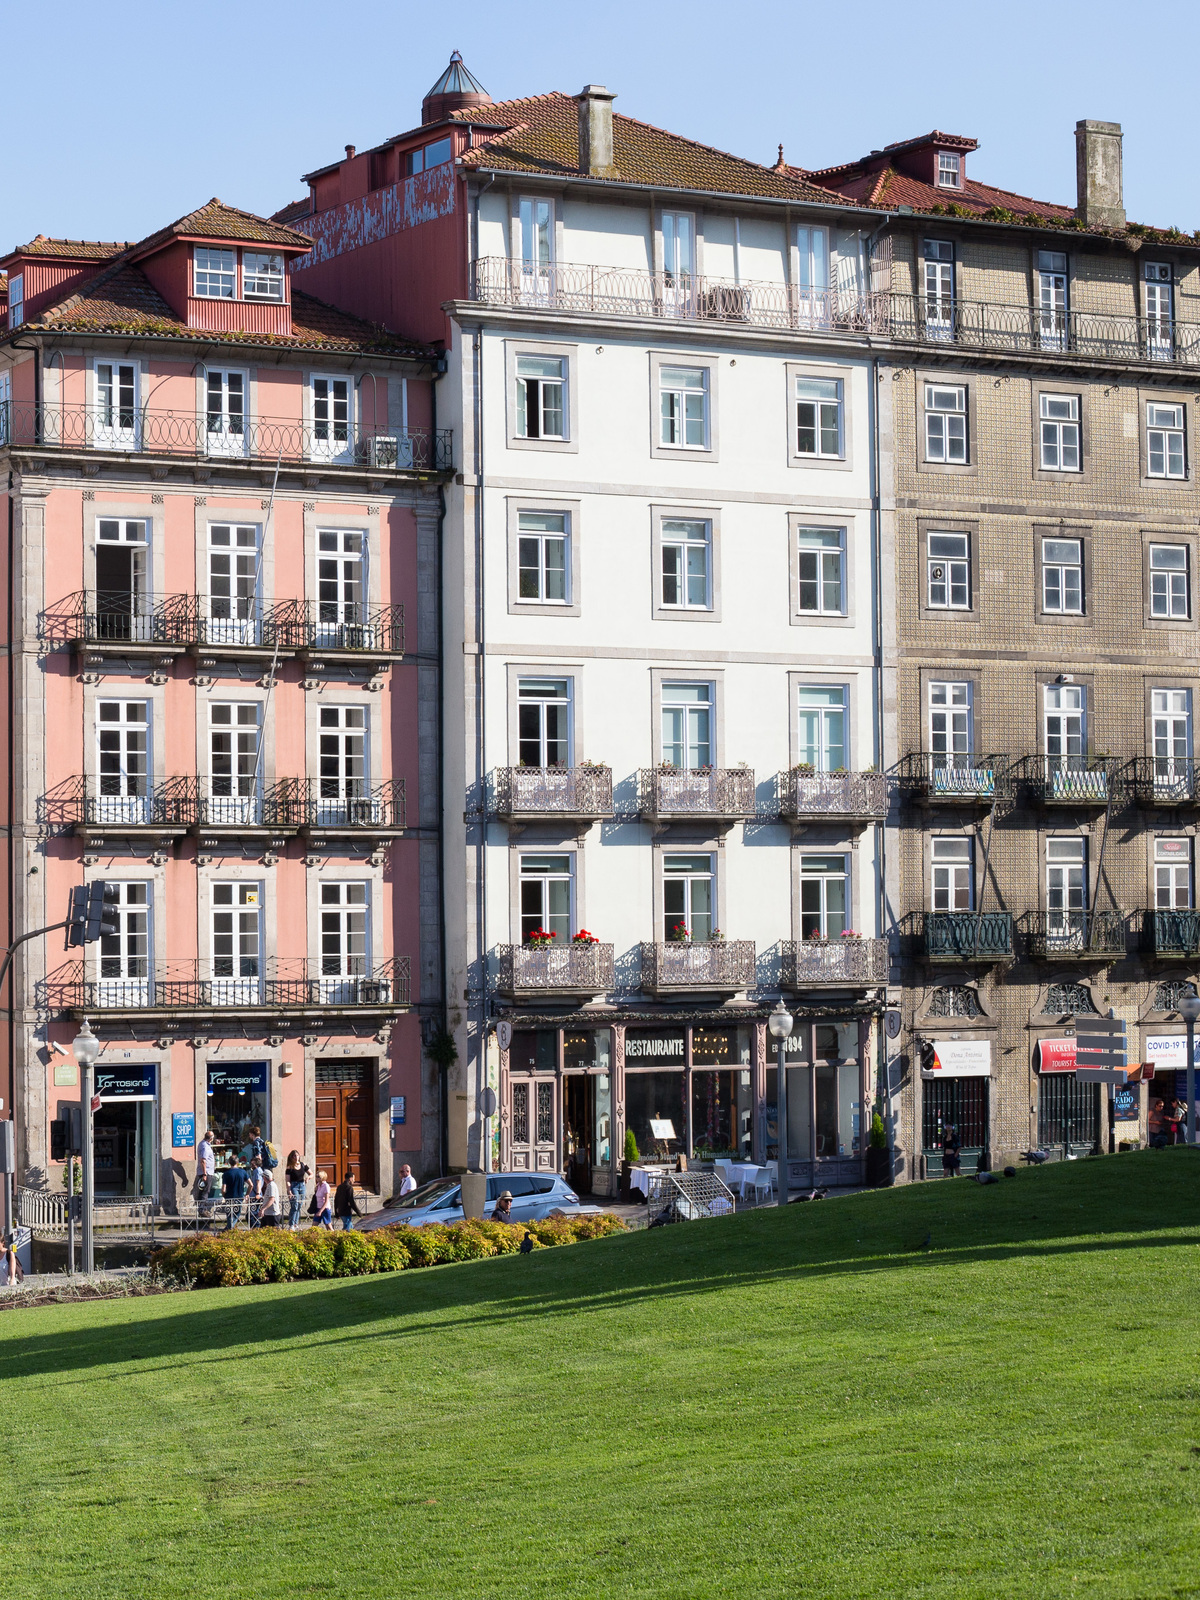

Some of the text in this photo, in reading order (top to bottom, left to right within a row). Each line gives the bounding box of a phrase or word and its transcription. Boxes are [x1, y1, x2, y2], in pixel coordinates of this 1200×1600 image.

[625, 1039, 684, 1056] RESTAURANTE
[1049, 1044, 1071, 1052] TICKET
[1147, 1041, 1180, 1049] COVID-19
[1116, 1096, 1134, 1104] FADO
[177, 1125, 191, 1135] SHOP
